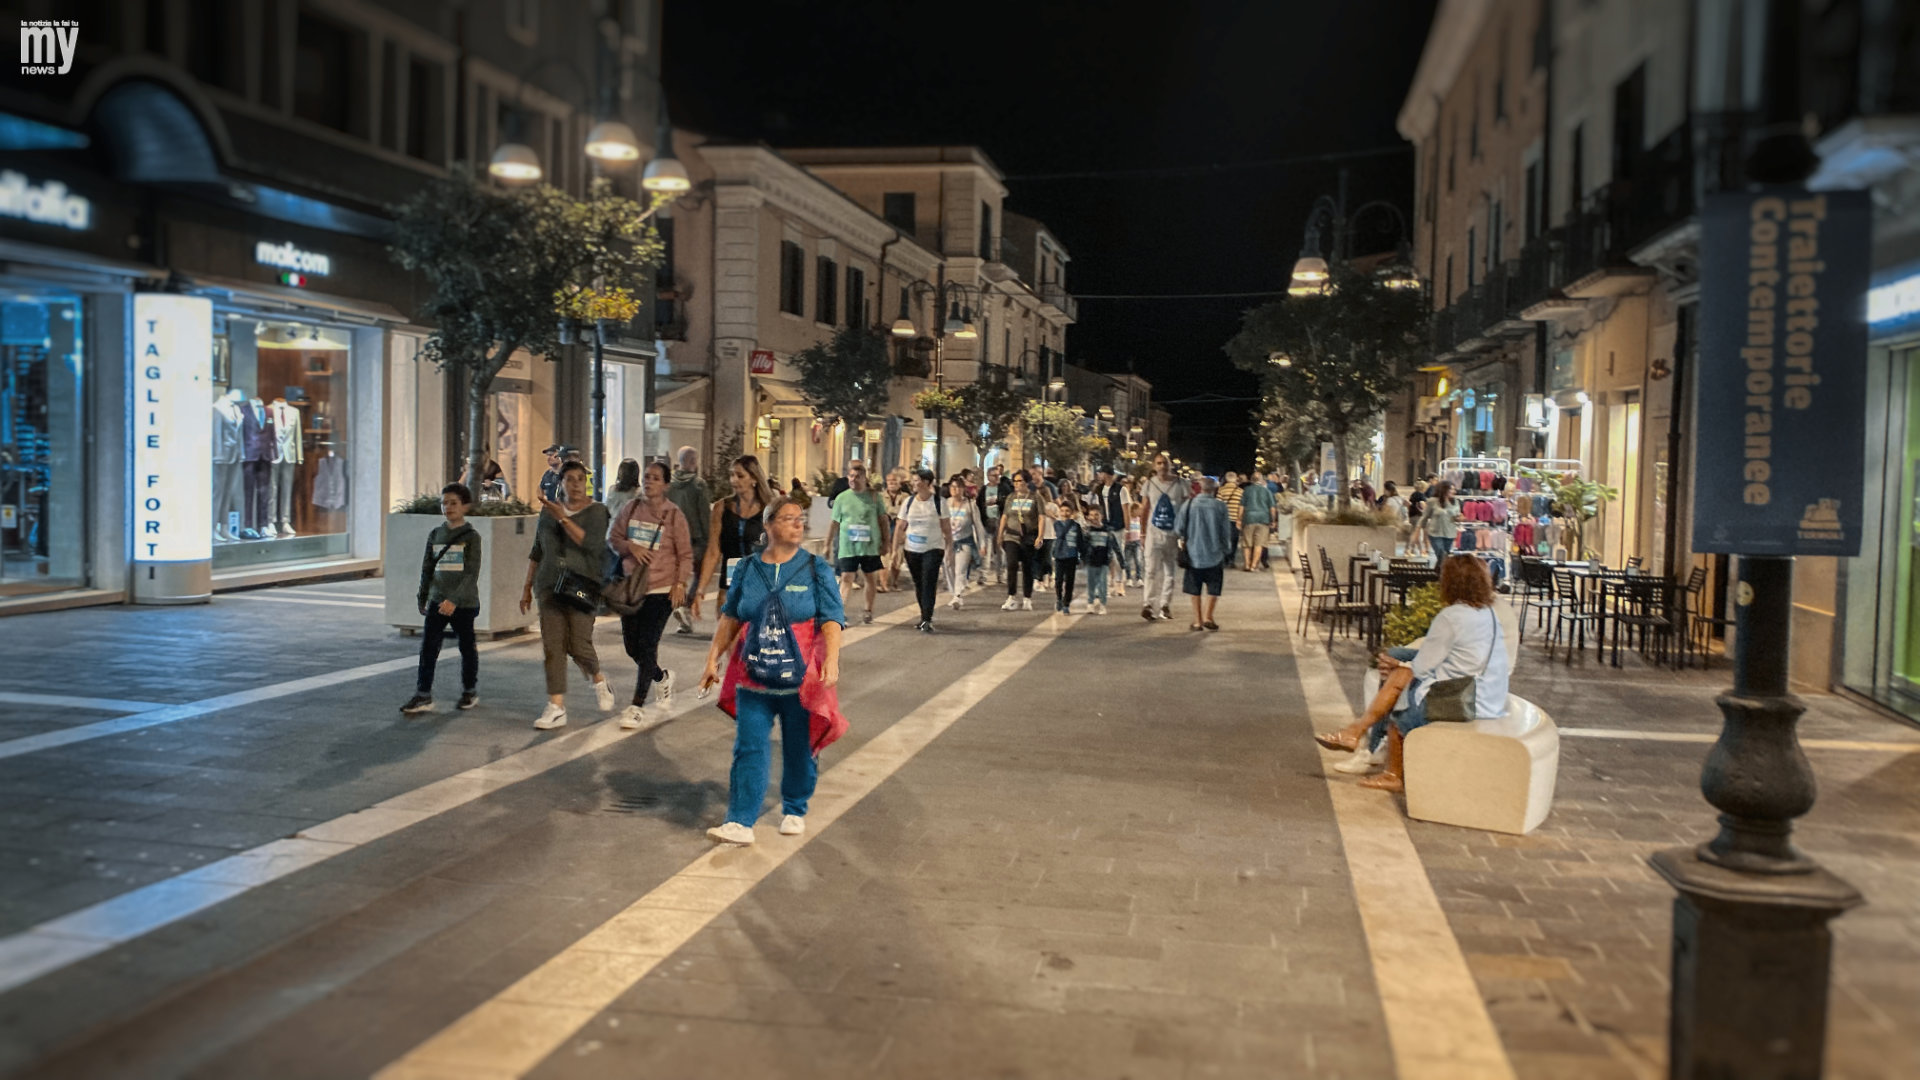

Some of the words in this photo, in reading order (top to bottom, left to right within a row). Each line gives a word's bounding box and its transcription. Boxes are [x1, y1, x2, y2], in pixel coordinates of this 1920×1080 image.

[0, 169, 90, 230] italia
[256, 241, 330, 276] malcom
[1784, 195, 1827, 410] Traiettorie
[145, 319, 161, 449] TAGLIE
[752, 354, 772, 371] illy
[1741, 197, 1787, 505] Contemporanee
[145, 474, 161, 580] FORTI
